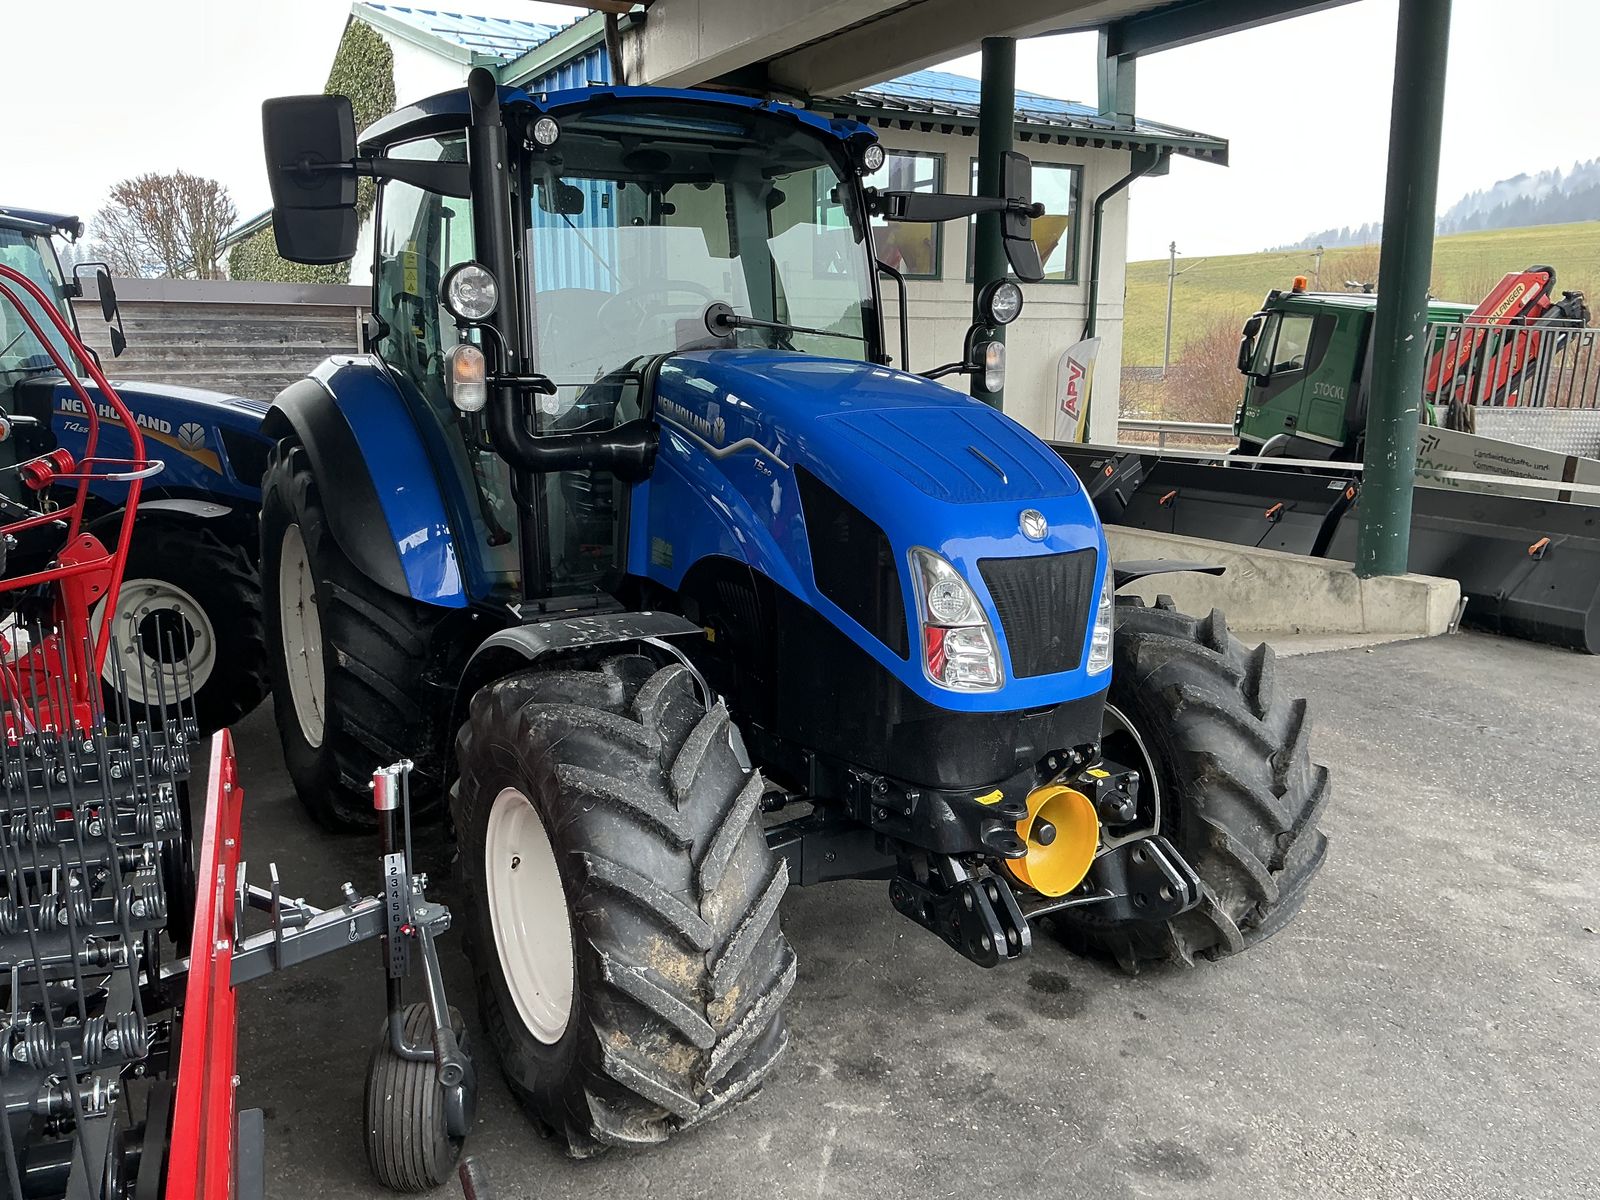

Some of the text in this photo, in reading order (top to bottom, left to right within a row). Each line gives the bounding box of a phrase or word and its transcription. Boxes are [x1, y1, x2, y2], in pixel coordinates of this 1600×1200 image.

[1488, 285, 1524, 325] PALFINGER
[1065, 364, 1082, 413] APV
[98, 404, 172, 434] HOAND
[657, 395, 711, 437] NEW HOLLAND
[390, 855, 395, 864] 1
[390, 866, 397, 876] 2
[391, 878, 398, 887] 3
[391, 890, 399, 899] 4
[392, 902, 400, 911] 5
[392, 914, 400, 922] 6
[394, 925, 400, 933] 7
